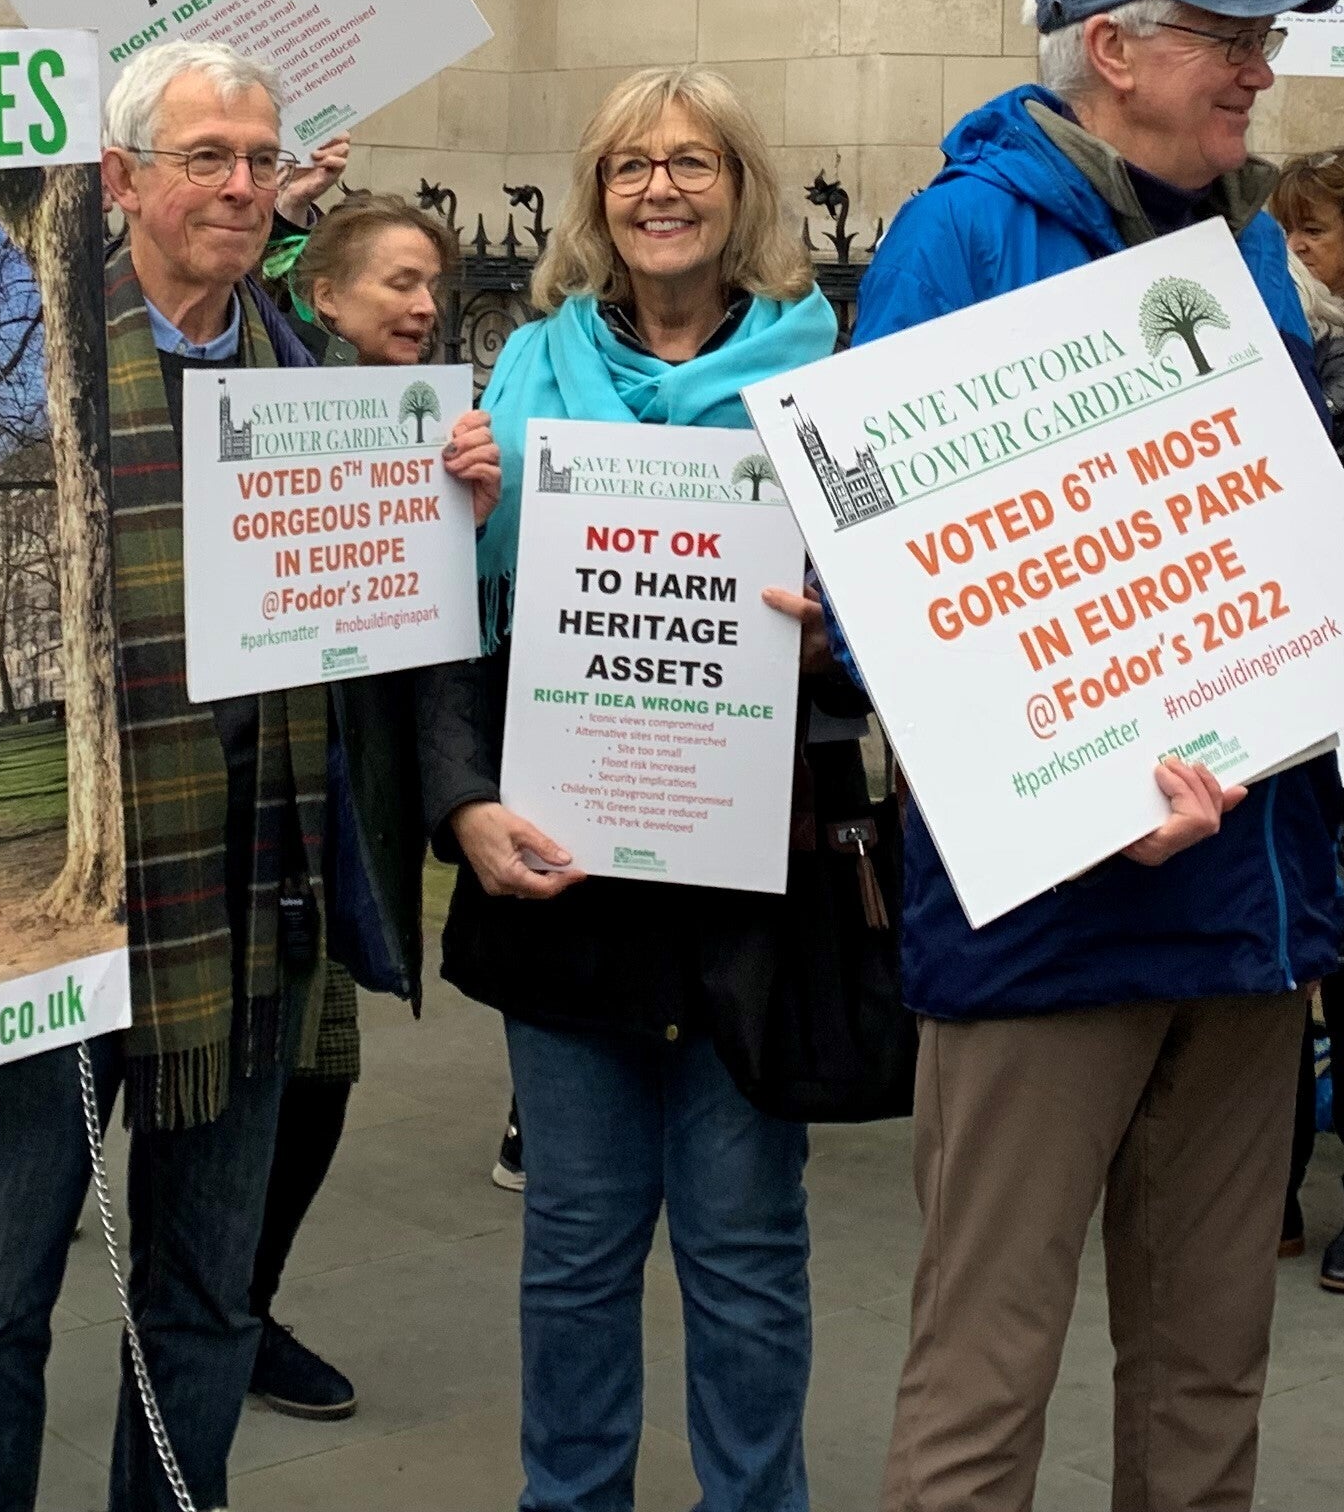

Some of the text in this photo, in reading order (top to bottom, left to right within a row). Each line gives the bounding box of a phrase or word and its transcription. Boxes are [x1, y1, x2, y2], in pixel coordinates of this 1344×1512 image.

[211, 1, 242, 22] views
[228, 1, 297, 48] Site too small
[232, 8, 257, 27] sites
[271, 4, 321, 40] increased
[109, 17, 169, 64] RIGHT
[309, 5, 377, 53] compromised
[319, 33, 361, 65] reduced
[1227, 343, 1264, 373] .co.uk
[863, 330, 1126, 455] SAVE VICTORIA
[251, 398, 389, 426] SAVE VICTORIA
[889, 357, 1182, 497] TOWER GARDENS
[256, 424, 410, 457] TOWER GARDENS
[237, 458, 435, 500] VOTED 6TH MOST
[571, 456, 721, 480] SAVE VICTORIA
[574, 476, 744, 504] TOWER GARDENS
[905, 407, 1242, 577] VOTED 6TH MOST
[232, 495, 441, 545] GORGEOUS PARK
[275, 537, 406, 578] IN EUROPE
[586, 525, 722, 559] NOT OK
[927, 456, 1284, 641] GORGEOUS PARK
[262, 571, 419, 623] @Fodor's 2022
[575, 567, 737, 603] TO HARM
[1018, 538, 1247, 672] IN EUROPE
[240, 604, 440, 653] #parksmatter #nobuildinginapark
[558, 608, 739, 646] HERITAGE
[585, 654, 723, 689] ASSETS
[1026, 580, 1291, 740] @Fodor's 2022
[533, 688, 774, 720] RIGHT IDEA WRONG PLACE
[1011, 615, 1343, 799] #parksmatter #nobuildinginapark
[574, 725, 728, 748] Alternative sites not researched
[588, 712, 715, 732] Iconic views compromised
[616, 743, 682, 758] Site too small
[1178, 729, 1220, 758] London
[598, 770, 698, 789] Security implications
[601, 756, 697, 775] Flood risk increased
[583, 799, 709, 820] 27% Green space reduced
[609, 787, 734, 808] playground compromised
[618, 817, 694, 834] Park developed
